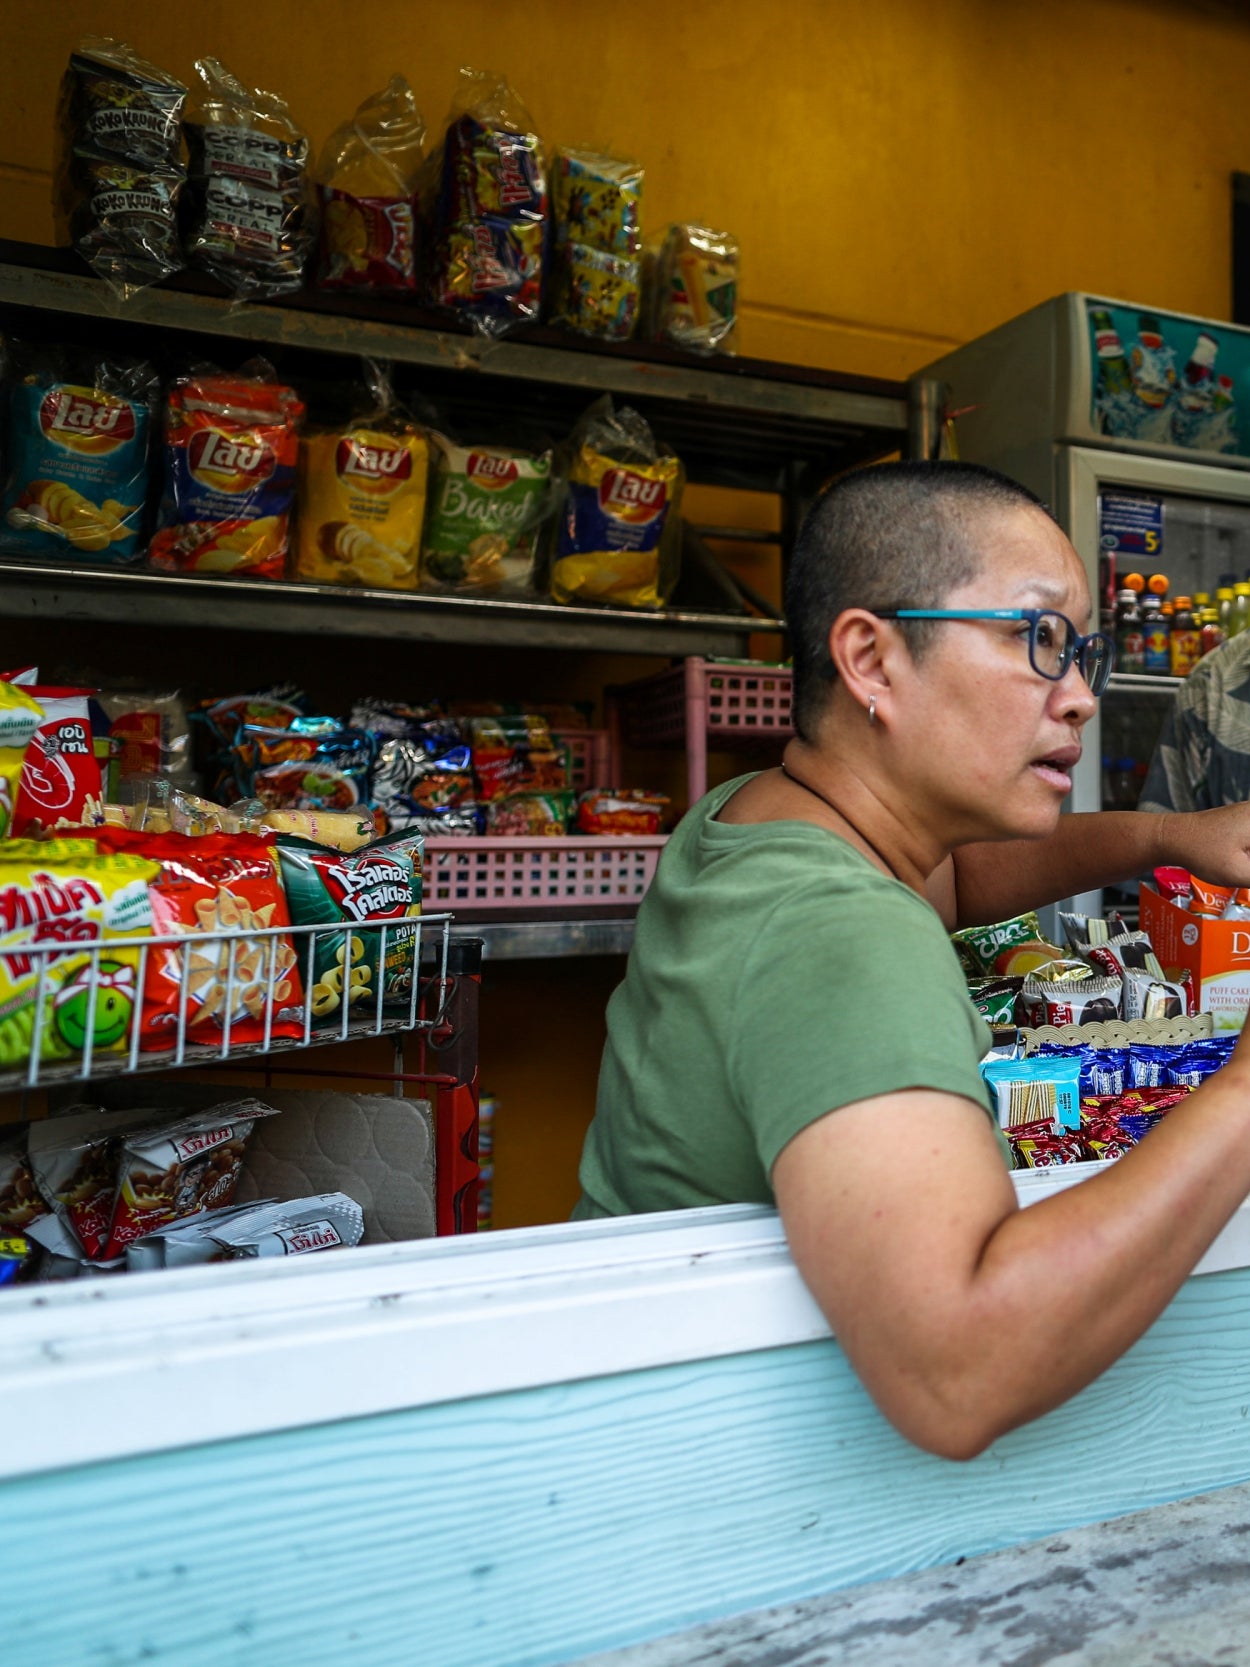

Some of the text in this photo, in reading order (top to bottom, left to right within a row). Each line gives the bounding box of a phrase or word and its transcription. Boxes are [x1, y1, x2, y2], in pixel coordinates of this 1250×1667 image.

[127, 194, 175, 221] KRUNC
[441, 479, 532, 522] Baked
[328, 864, 410, 894] โรลเลอร์
[342, 886, 413, 922] โคสเตอร์
[1209, 996, 1231, 1004] WITH
[1210, 987, 1229, 995] PUFF
[1053, 1002, 1067, 1026] Pie
